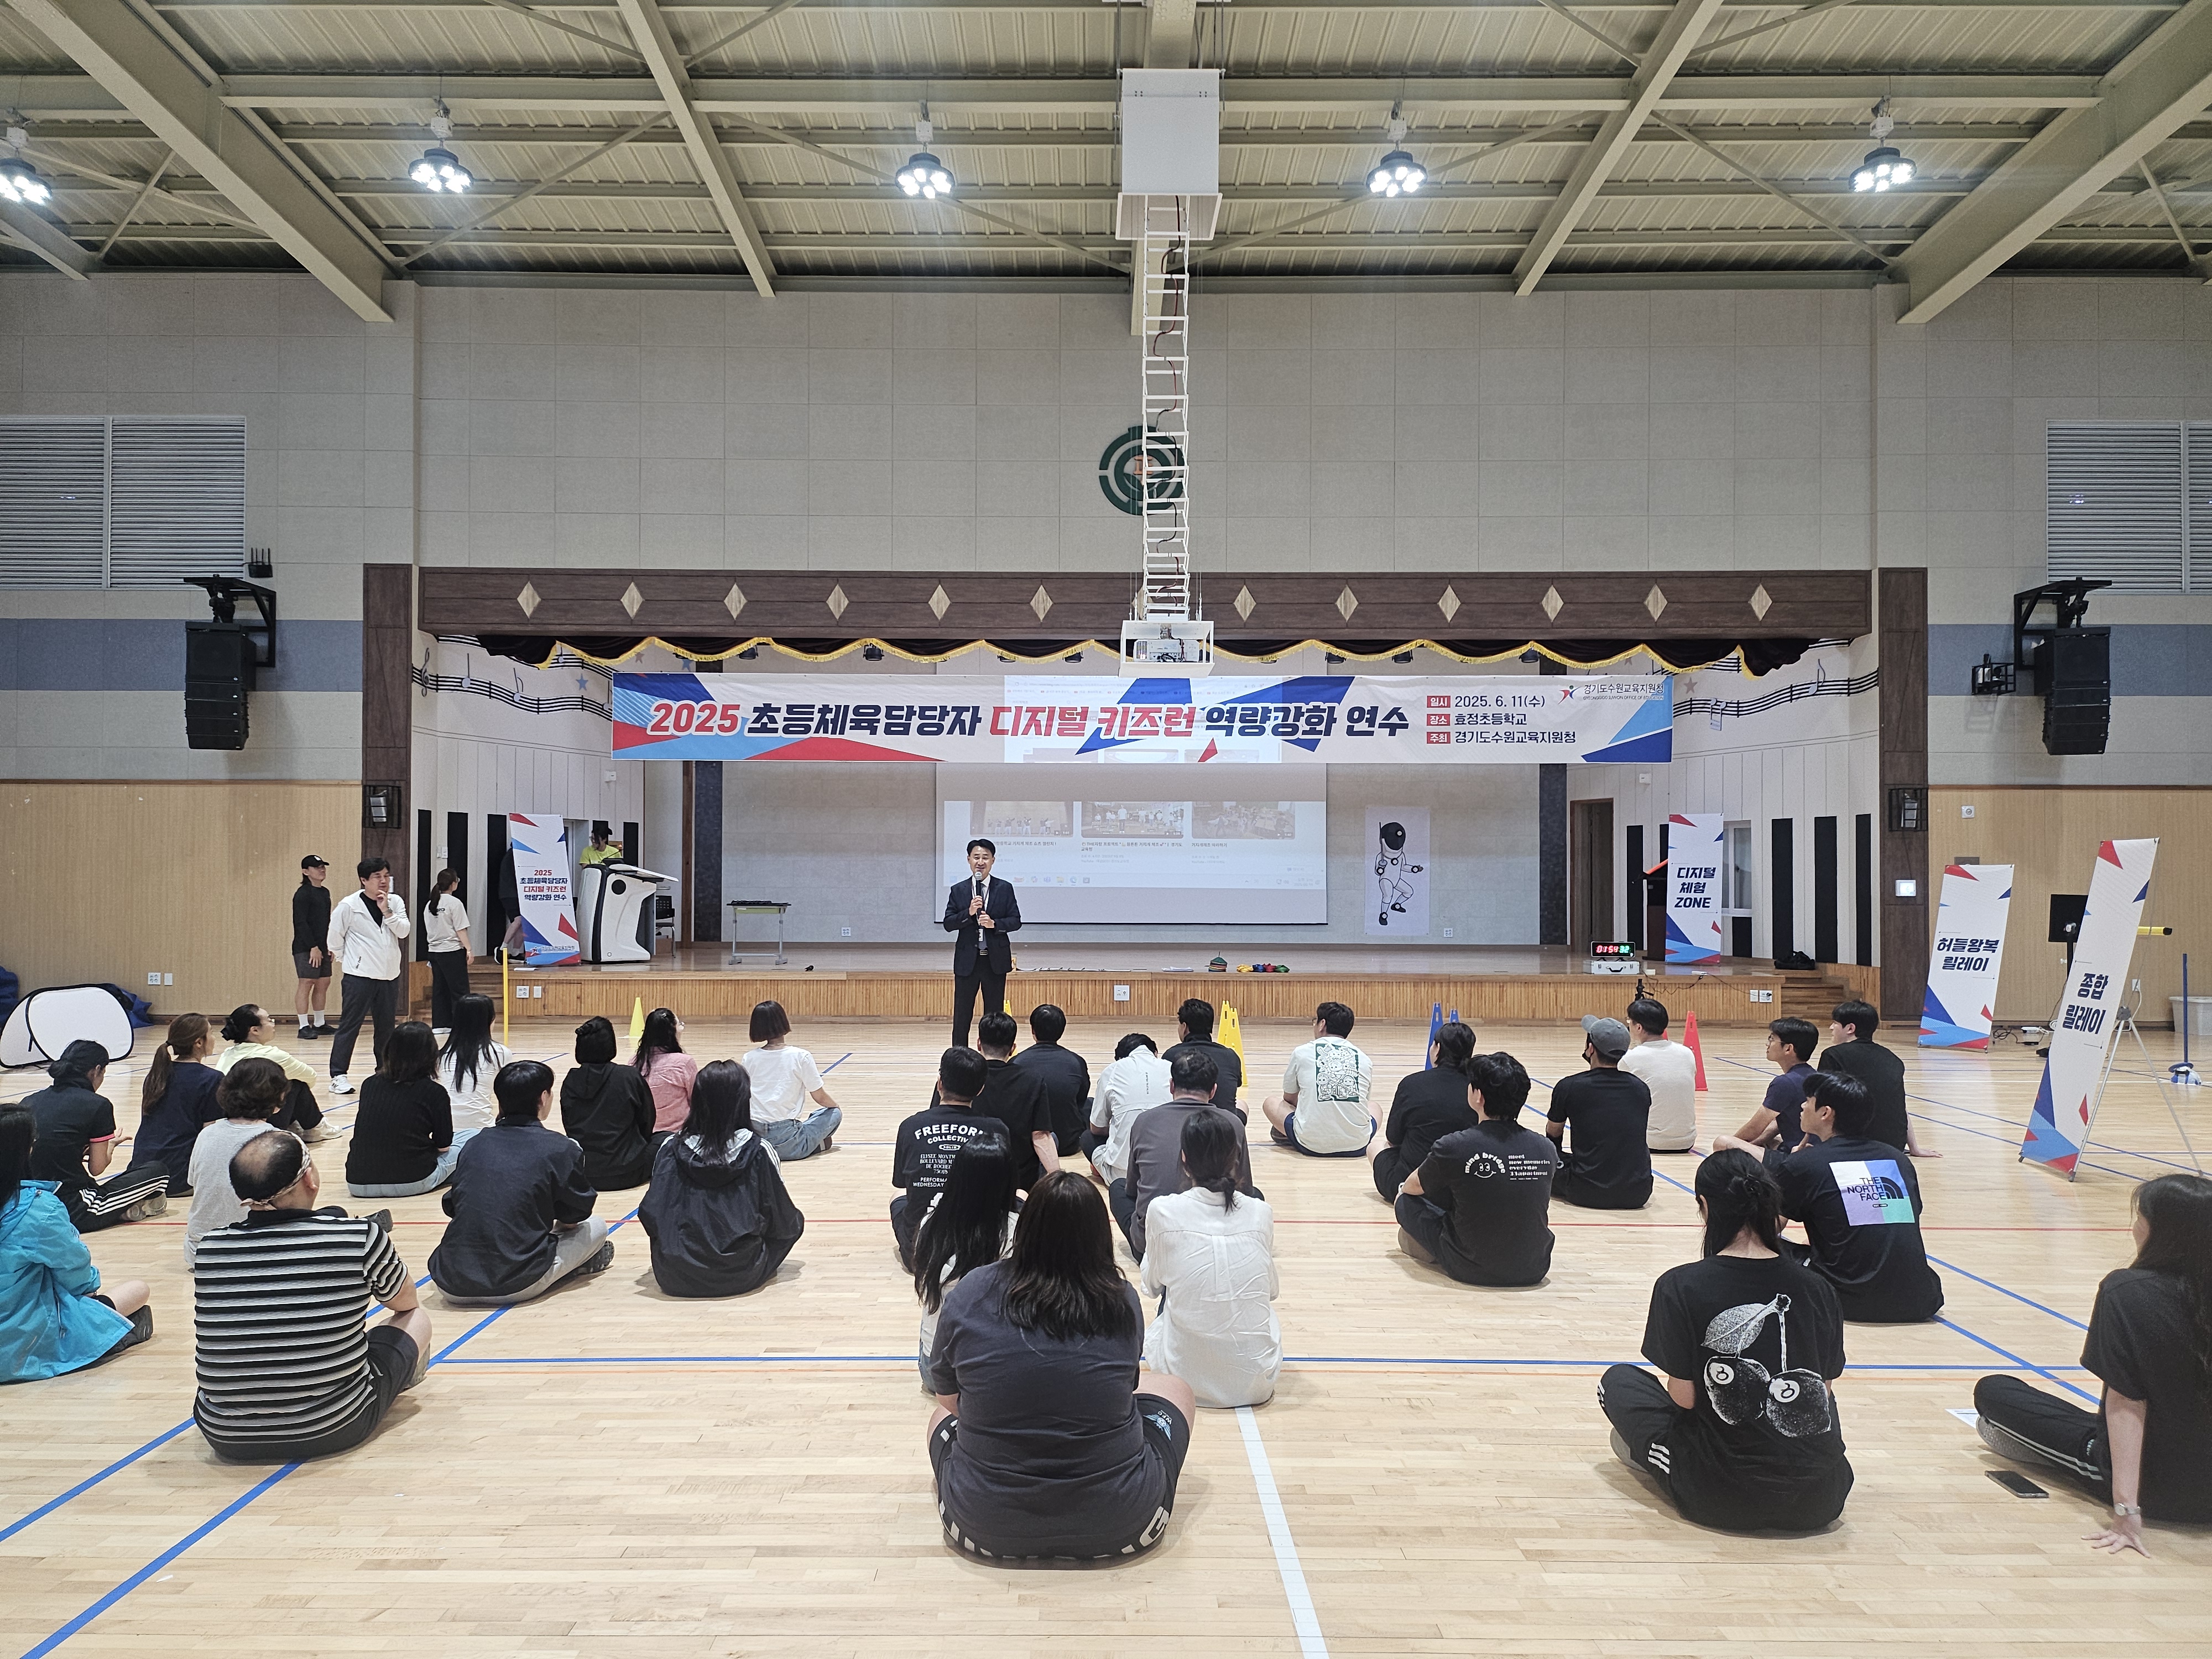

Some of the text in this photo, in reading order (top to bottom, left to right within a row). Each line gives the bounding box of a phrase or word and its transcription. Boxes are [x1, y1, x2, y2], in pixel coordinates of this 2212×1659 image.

[1584, 683, 1664, 694] 경기도수원교육지원청
[1430, 695, 1545, 708] 일시 2025. 6. 11(수)
[649, 702, 1410, 738] 2025 초등체육담당자 디지털 키즈런 역량강화 연수
[1430, 713, 1527, 726] 장소 효정초등학교
[1430, 731, 1576, 744] 주최 경기도수원교육지원청
[1677, 867, 1717, 879] 디지털
[1679, 882, 1706, 894] 체험
[1674, 897, 1712, 909] ZONE
[1937, 937, 2000, 954] 허들왕복
[1941, 956, 1989, 972] 릴레이
[2077, 973, 2110, 1001] 종합
[2062, 1004, 2107, 1035] 릴레이
[1464, 1152, 1506, 1173] mind bridge
[1859, 1177, 1881, 1186] THE
[1846, 1184, 1884, 1194] NORTH
[1860, 1192, 1887, 1202] FACE
